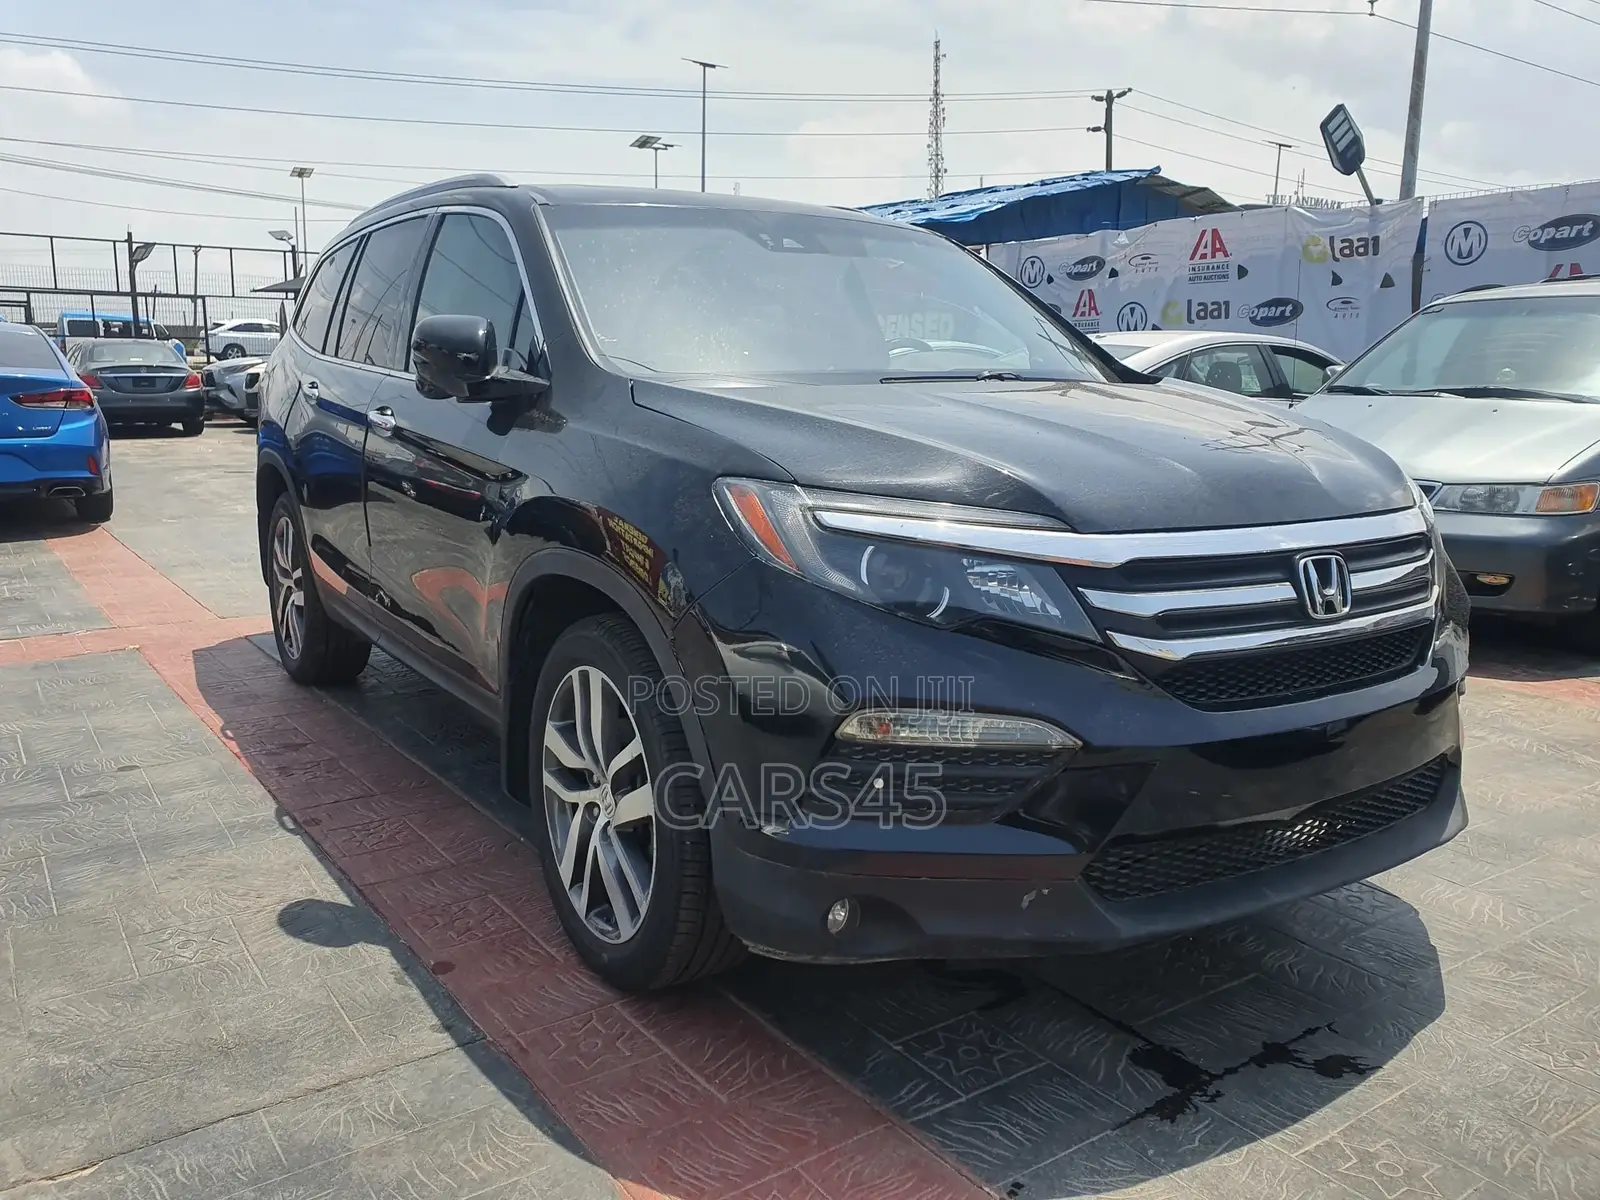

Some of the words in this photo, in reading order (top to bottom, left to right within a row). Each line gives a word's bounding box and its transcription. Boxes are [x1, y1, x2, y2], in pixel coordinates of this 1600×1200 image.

[1265, 194, 1287, 206] THE
[1288, 194, 1344, 210] LANDMARK
[1513, 220, 1594, 244] Copart
[1058, 259, 1099, 276] Copart
[1188, 263, 1230, 273] INSURANCE
[1203, 273, 1230, 281] AUCTIONS
[1238, 303, 1293, 320] Copart
